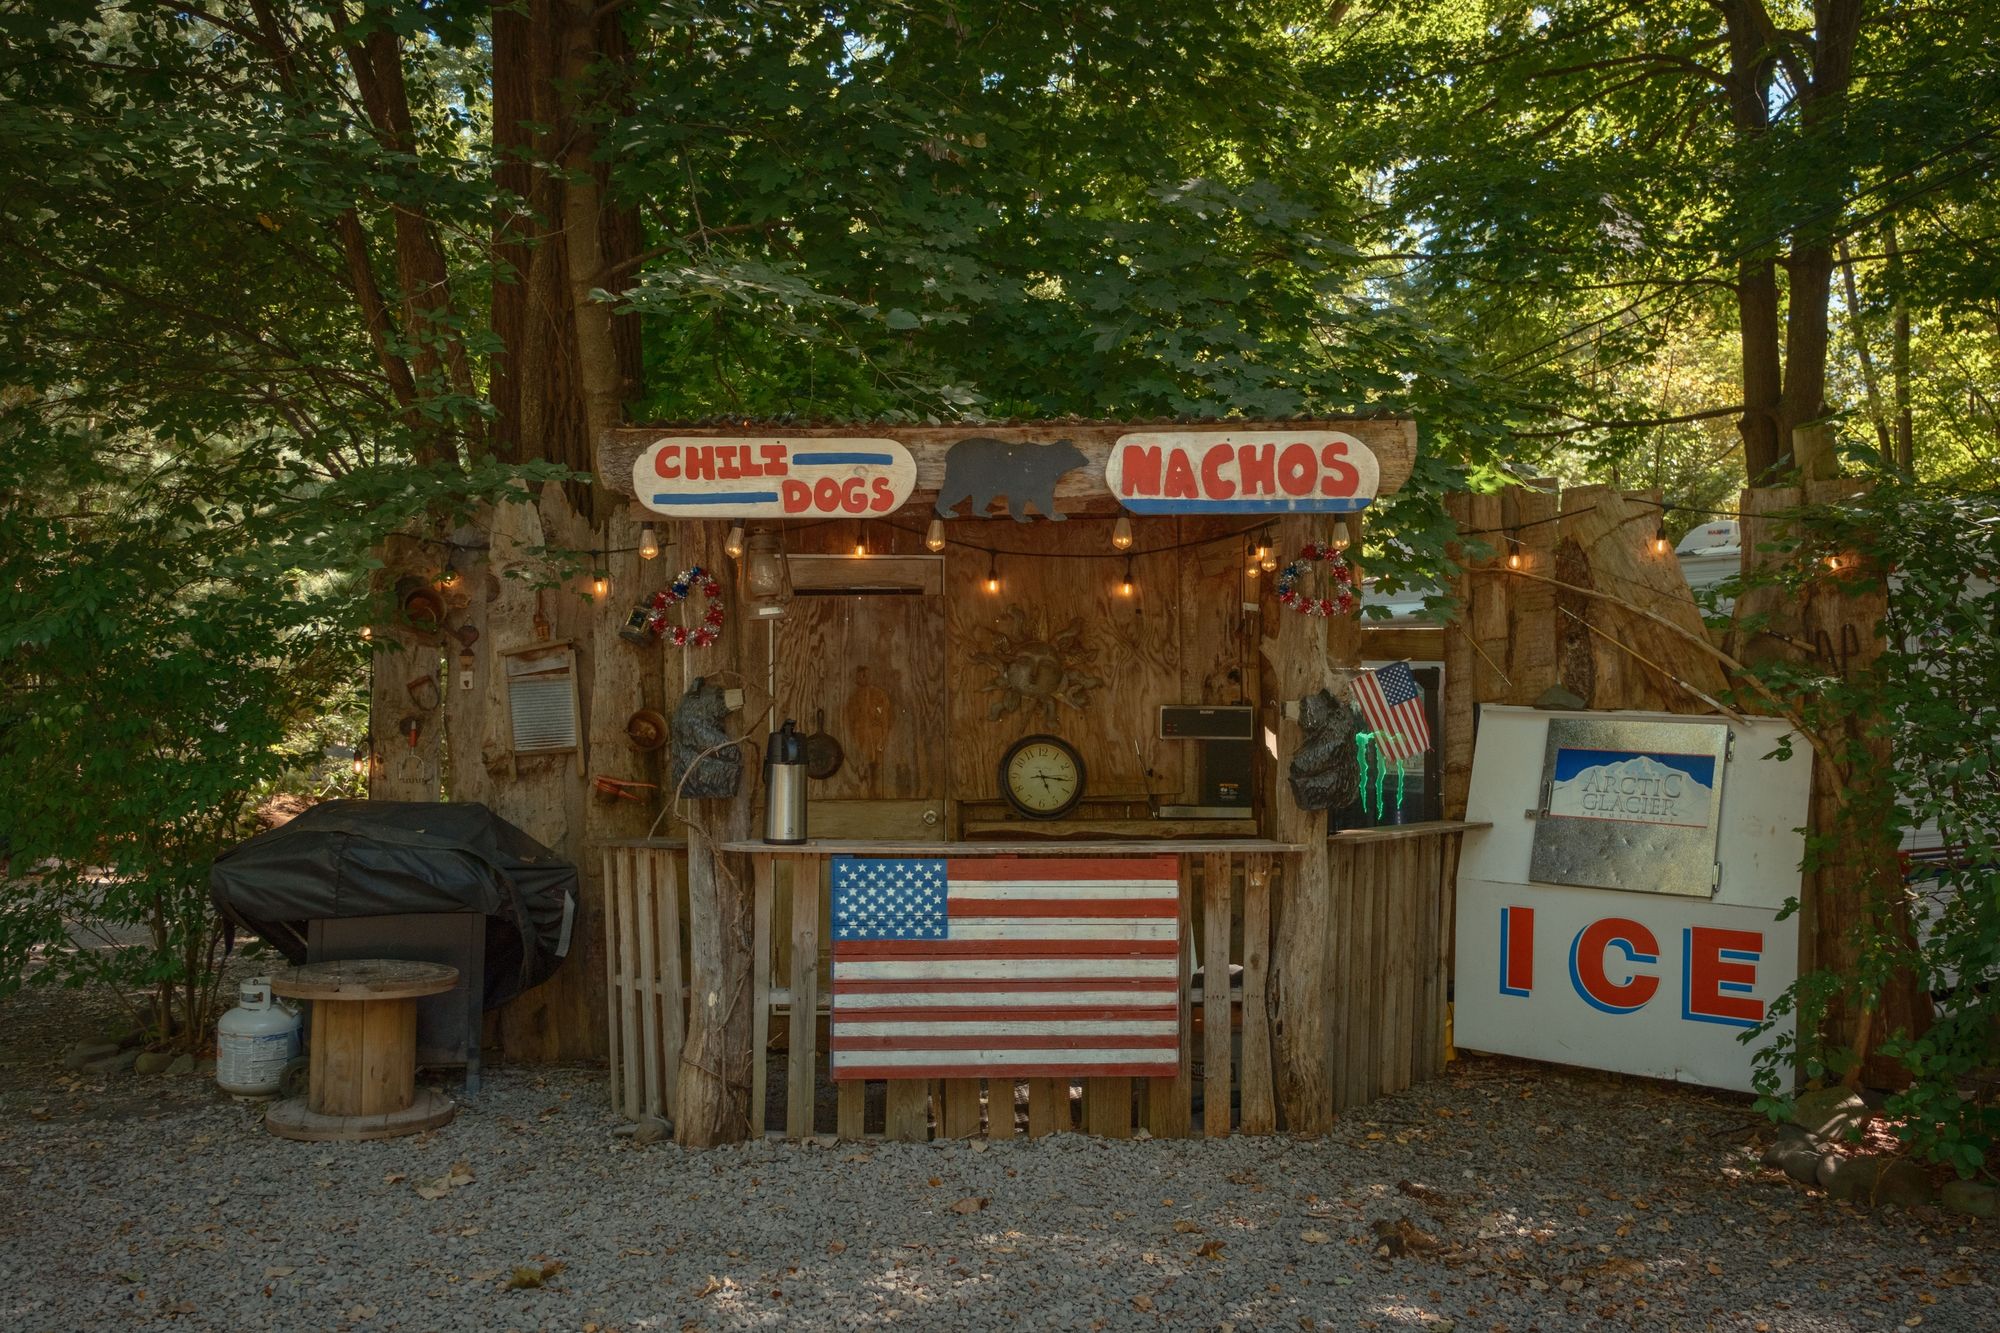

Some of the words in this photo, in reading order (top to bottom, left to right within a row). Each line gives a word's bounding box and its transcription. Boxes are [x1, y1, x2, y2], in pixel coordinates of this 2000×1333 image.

[655, 444, 788, 480] CHILI
[1121, 441, 1360, 500] NACHOS
[781, 477, 895, 513] DOGS
[1024, 750, 1034, 760] 11
[1039, 747, 1049, 757] 12
[1581, 769, 1683, 799] ARCTIC
[1582, 793, 1678, 816] GLACIER
[1500, 905, 1764, 1027] ICE
